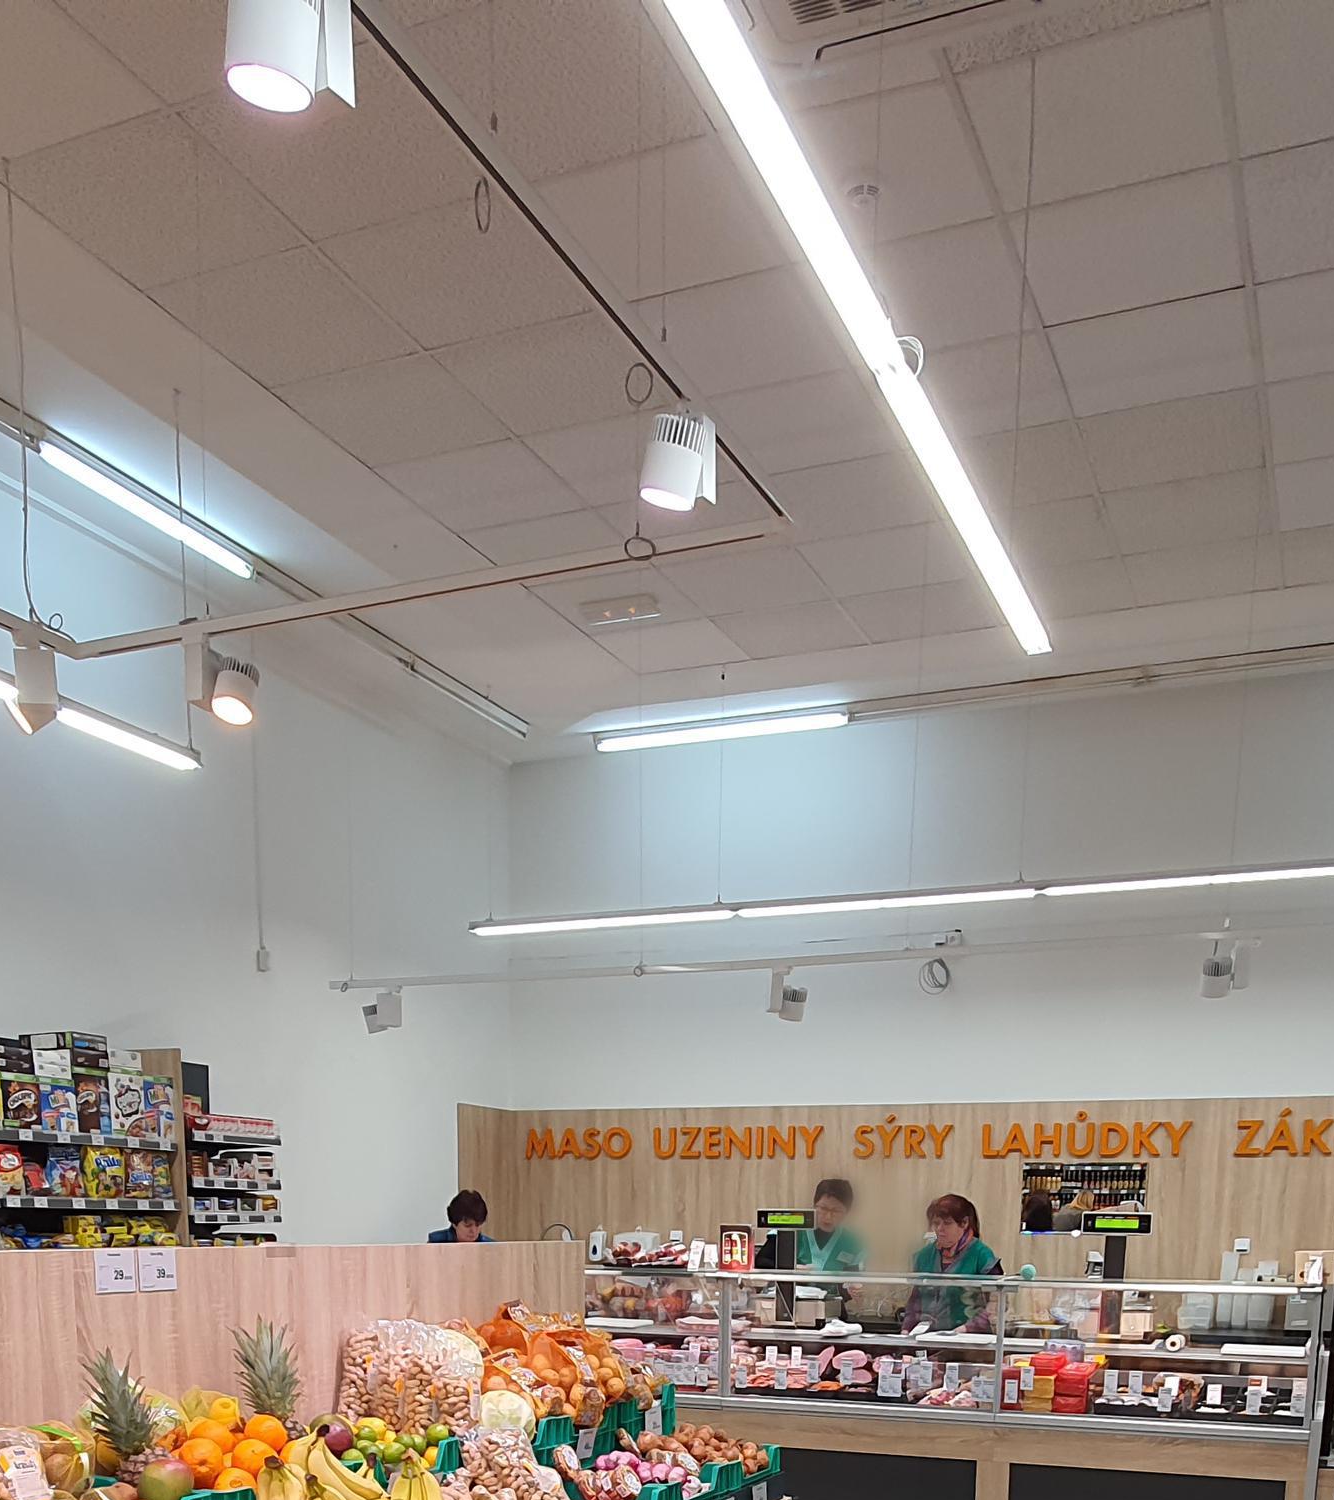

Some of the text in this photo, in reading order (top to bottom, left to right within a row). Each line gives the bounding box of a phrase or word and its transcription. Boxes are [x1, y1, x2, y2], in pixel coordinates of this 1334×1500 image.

[525, 1127, 633, 1160] MASO
[653, 1124, 825, 1160] UZENINY
[853, 1114, 955, 1159] SÝRY
[981, 1110, 1193, 1158] LAHŮDKY
[114, 1269, 124, 1280] 29
[156, 1268, 166, 1279] 39
